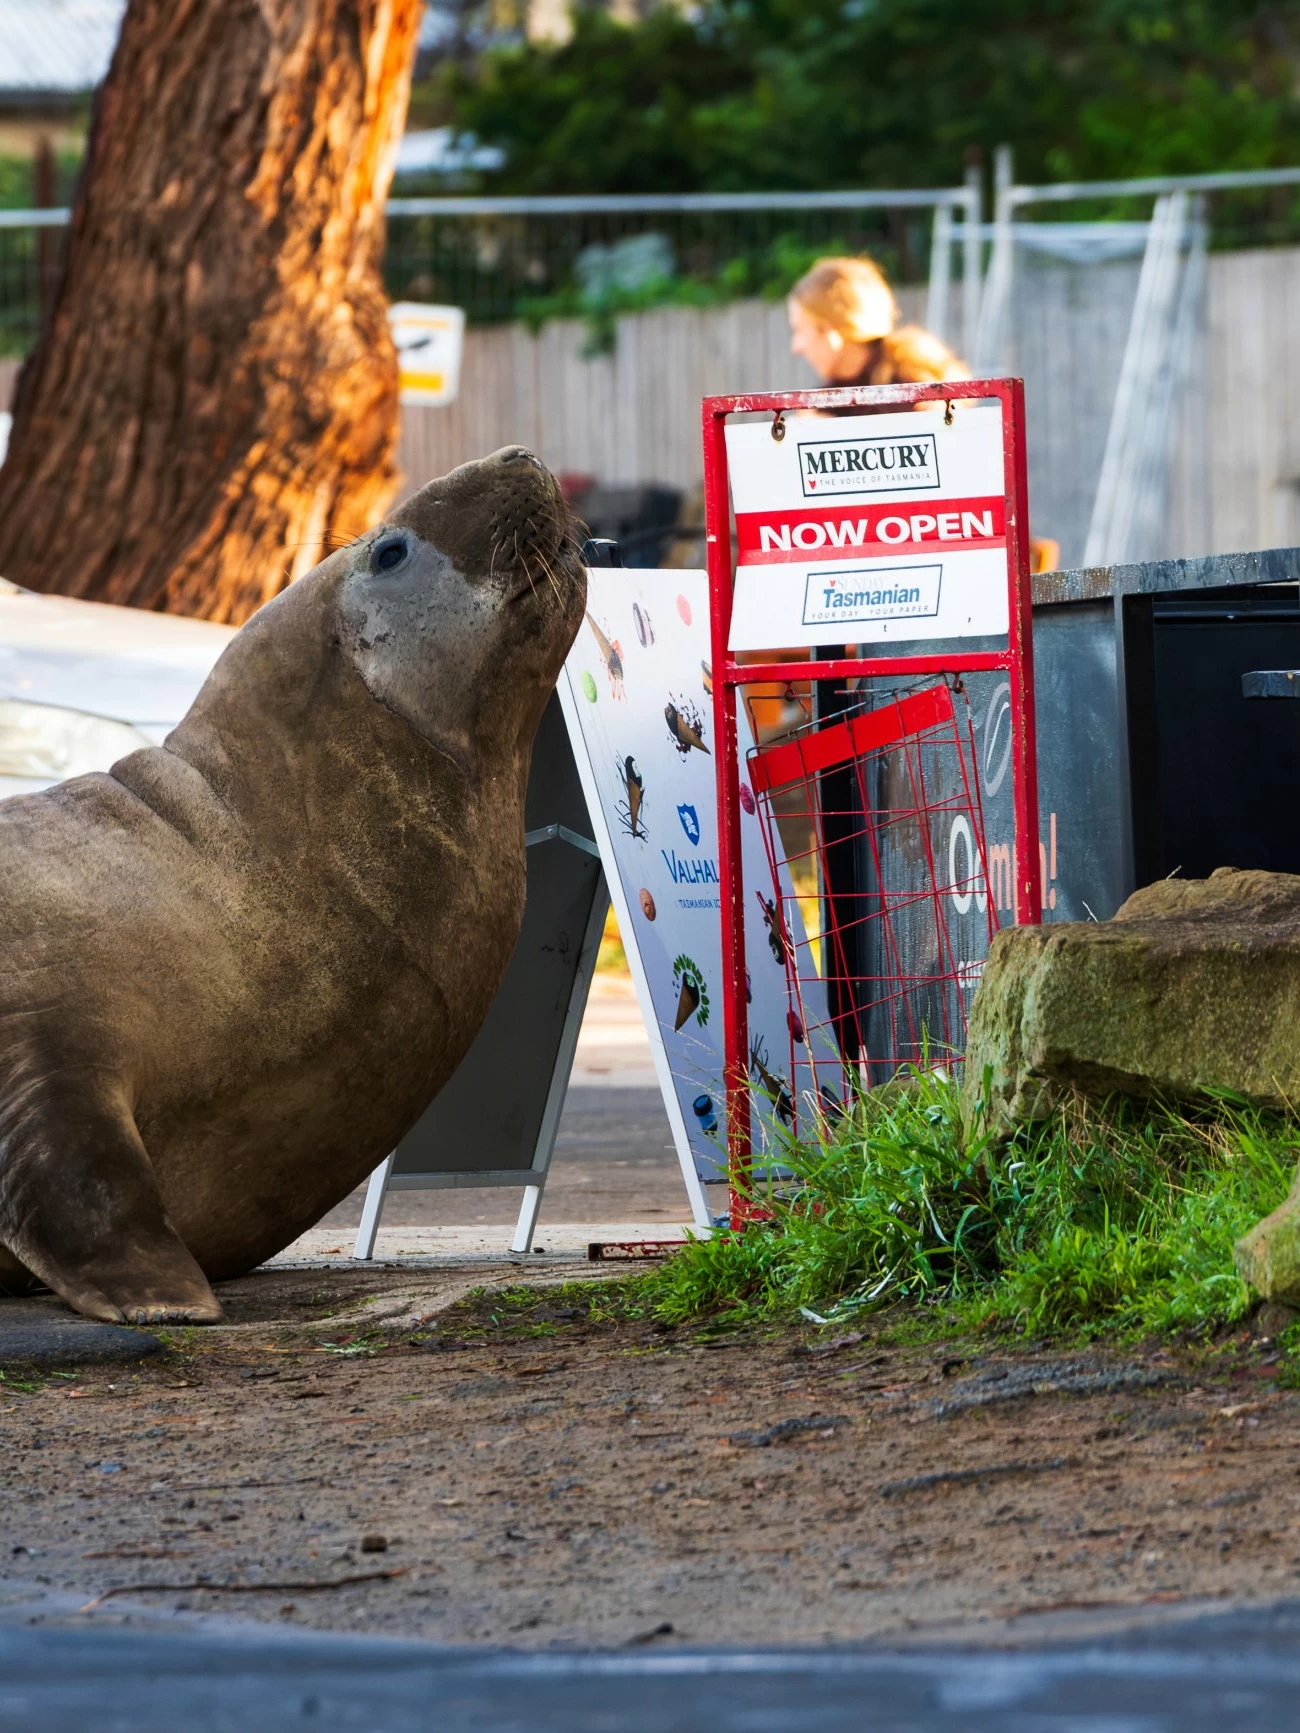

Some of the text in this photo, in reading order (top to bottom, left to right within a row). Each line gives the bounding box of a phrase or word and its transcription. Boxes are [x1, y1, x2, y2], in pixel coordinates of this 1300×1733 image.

[805, 444, 929, 475] MERCURY
[841, 477, 866, 485] VOICE
[871, 475, 881, 483] OF
[886, 473, 930, 481] TASMANIA
[759, 510, 994, 552] NOW OPEN
[823, 584, 920, 608] Tasmanian
[900, 605, 928, 613] PAPER
[661, 849, 720, 883] VALHAL
[678, 899, 713, 909] TASMANIAN
